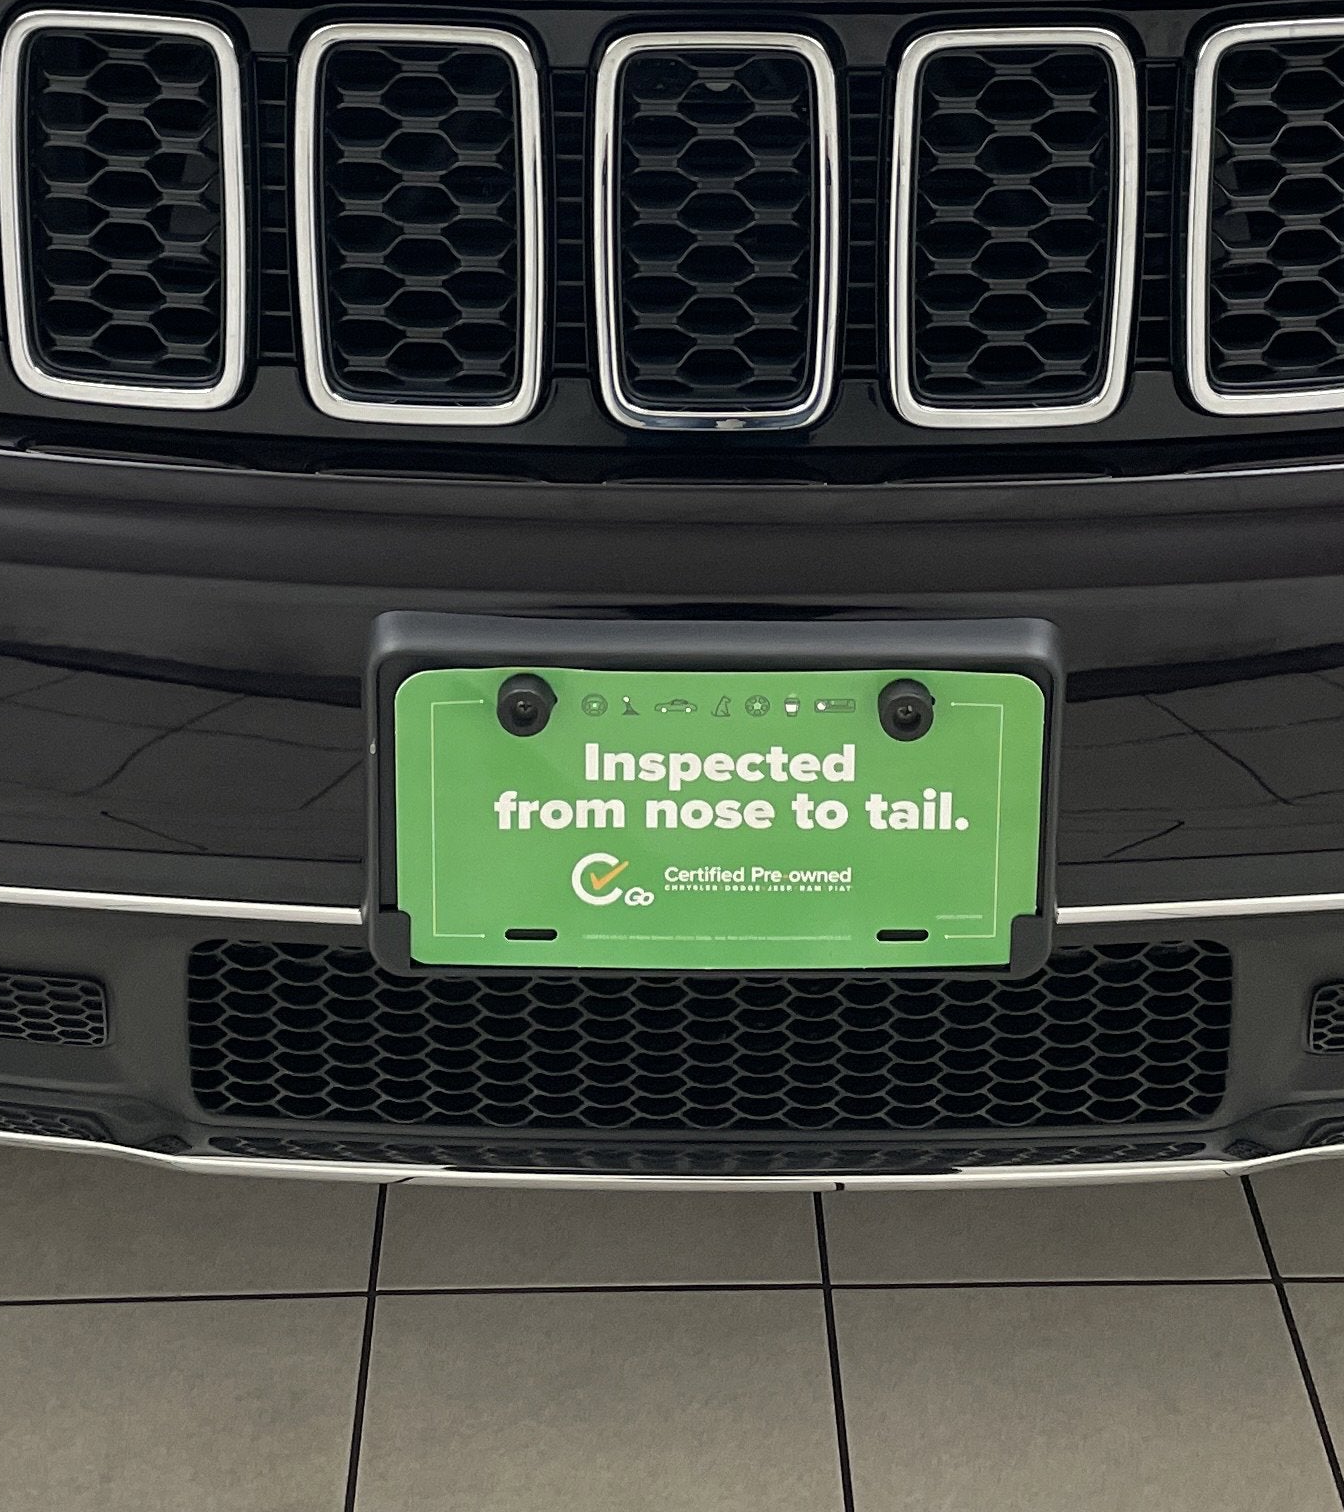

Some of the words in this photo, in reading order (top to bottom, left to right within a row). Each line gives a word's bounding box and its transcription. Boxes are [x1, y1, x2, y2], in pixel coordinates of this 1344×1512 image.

[585, 743, 855, 791] Inspected
[494, 791, 626, 830] from
[645, 798, 775, 829] nose
[792, 793, 849, 829] to
[865, 788, 970, 830] tail.
[664, 866, 745, 883] Certified
[751, 866, 852, 883] Pre-owned
[624, 886, 655, 906] Go
